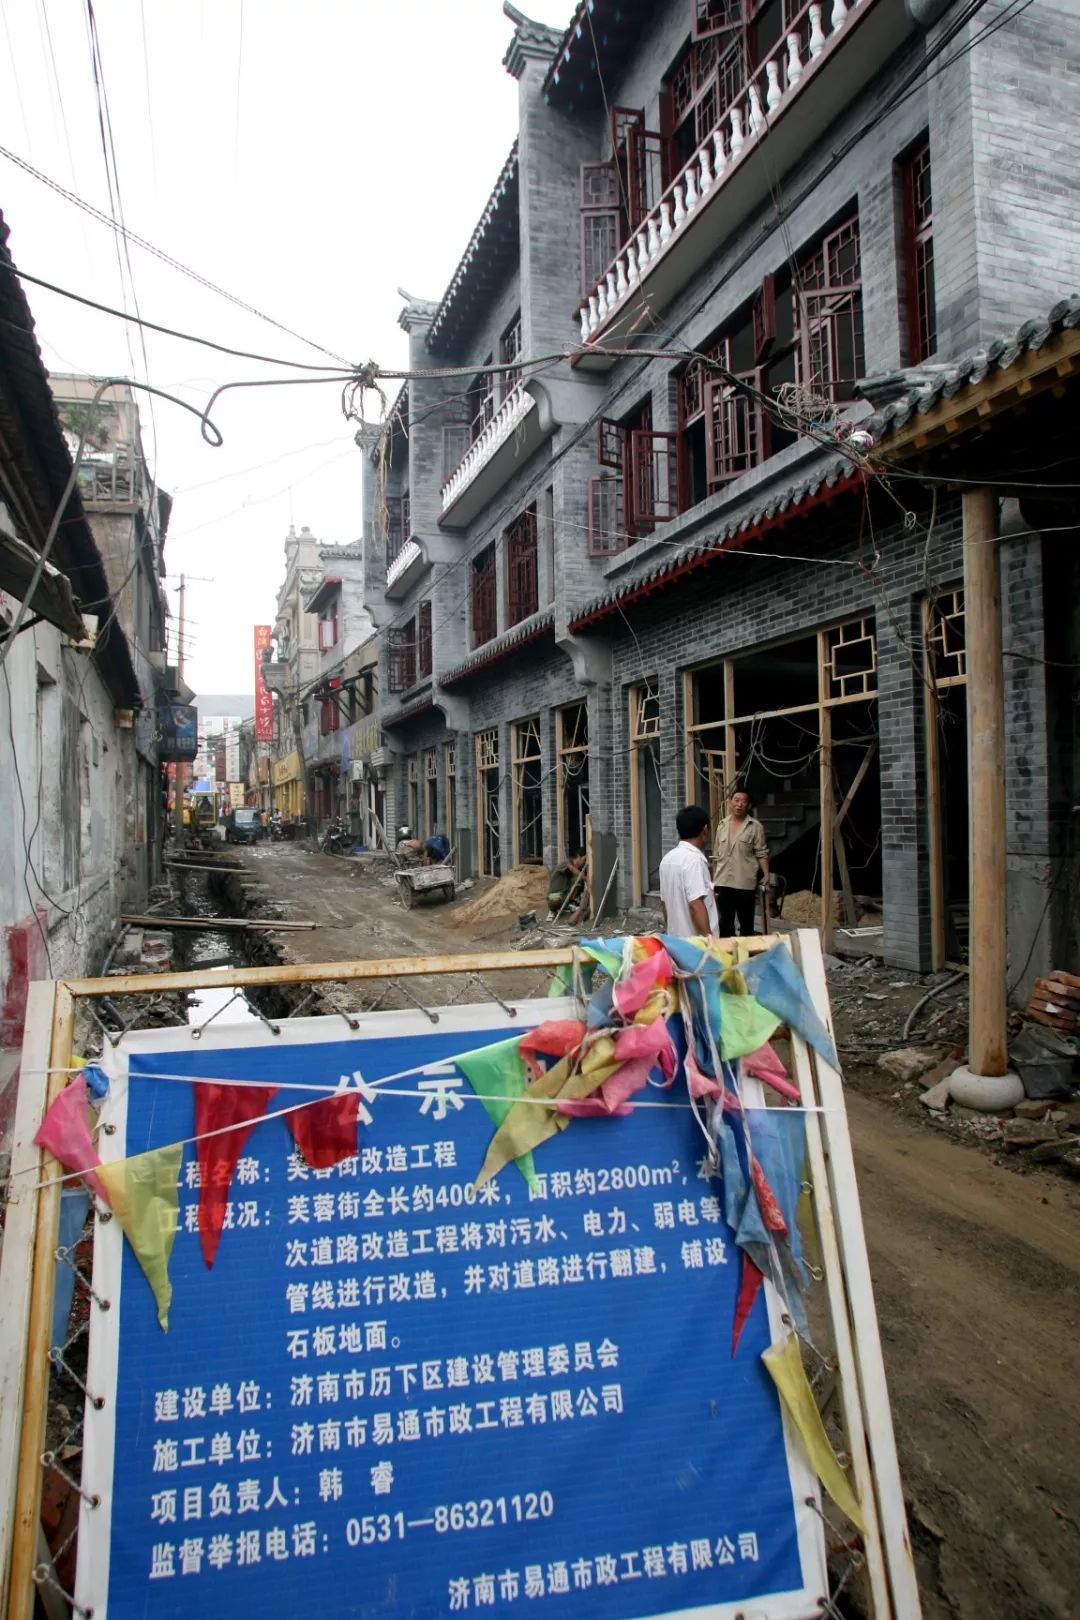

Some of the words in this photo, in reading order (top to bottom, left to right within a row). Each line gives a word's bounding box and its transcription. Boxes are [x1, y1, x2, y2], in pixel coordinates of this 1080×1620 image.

[285, 1196, 721, 1268] 次道路改造工程将对污水、电力、弱电等
[286, 1237, 728, 1314] 管线进行改造，并对道路进行翻建，铺设
[287, 1320, 400, 1359] 石板地面。
[448, 1531, 760, 1611] 济南市易通市政工程有限公司
